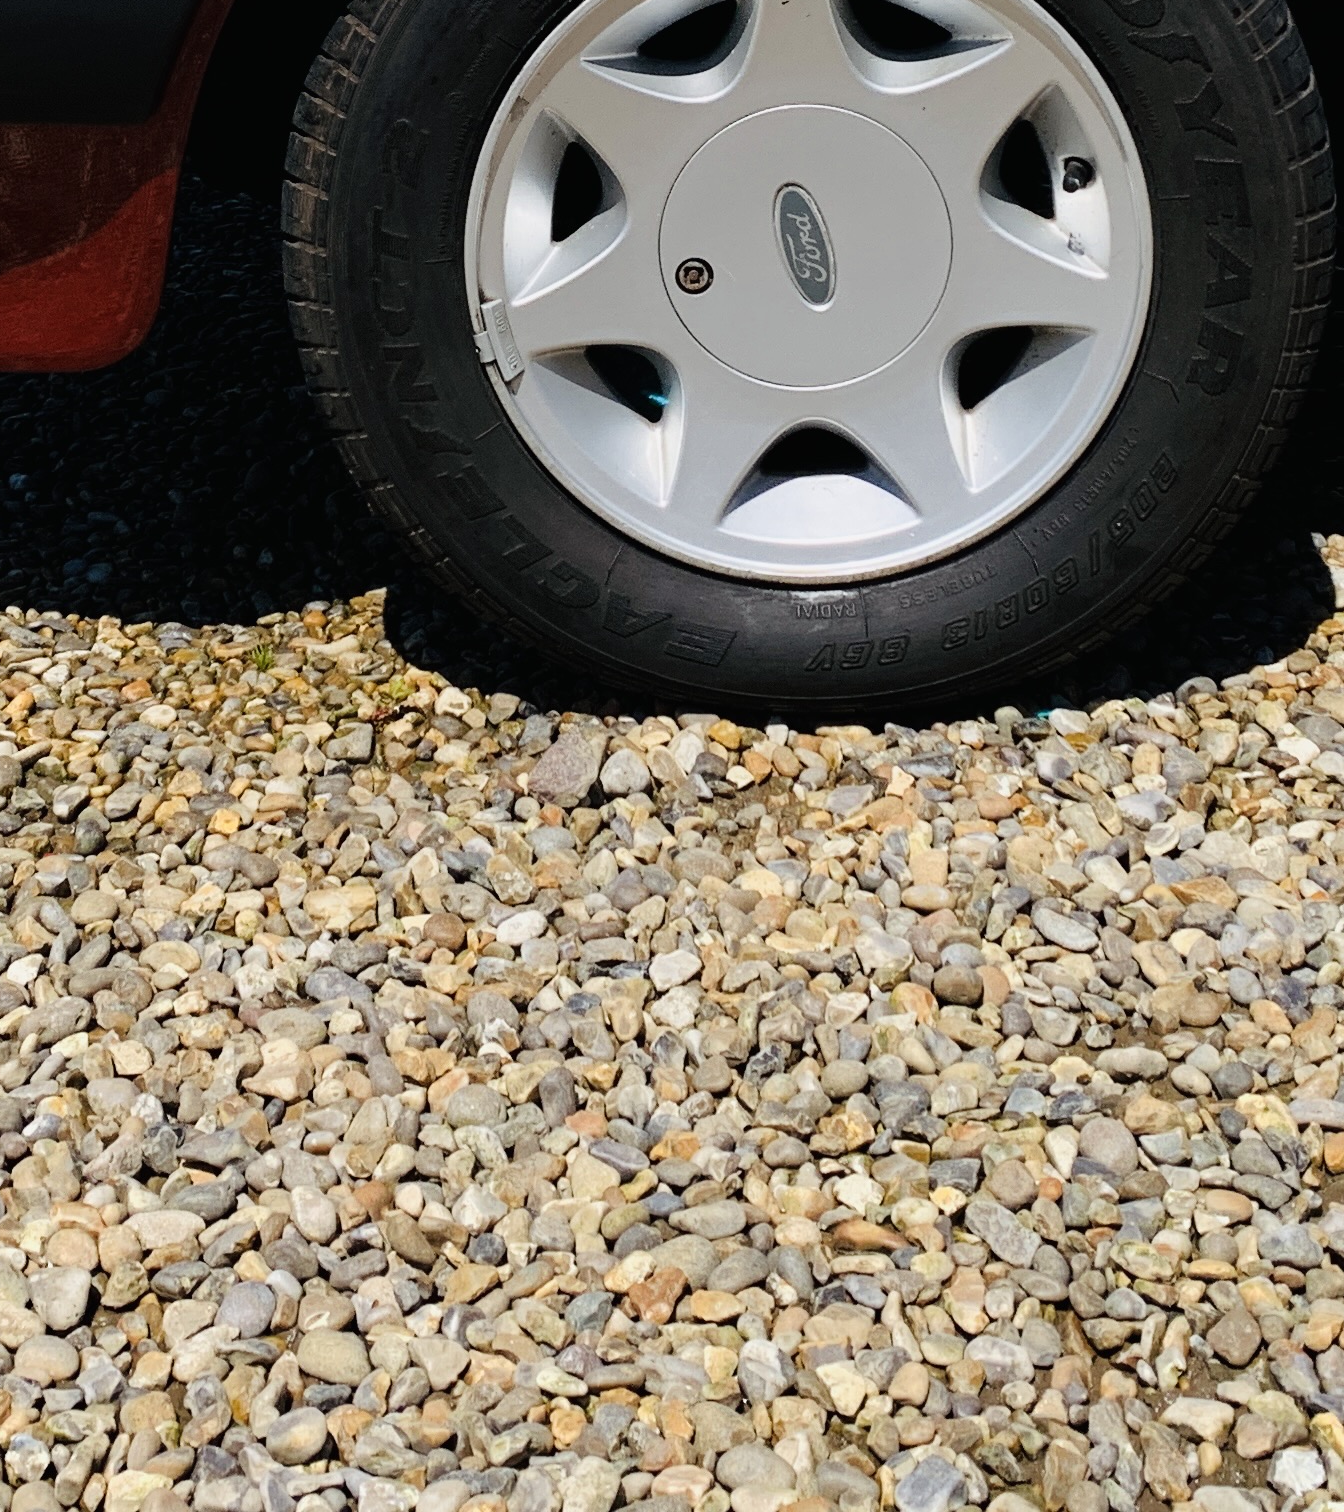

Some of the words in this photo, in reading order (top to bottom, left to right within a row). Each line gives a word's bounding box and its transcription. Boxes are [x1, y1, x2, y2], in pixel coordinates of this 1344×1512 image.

[786, 212, 827, 282] Ford
[435, 462, 738, 669] EAGLE
[940, 450, 1179, 653] 205/60R13
[792, 600, 858, 620] RADIAL
[803, 633, 911, 674] 86V
